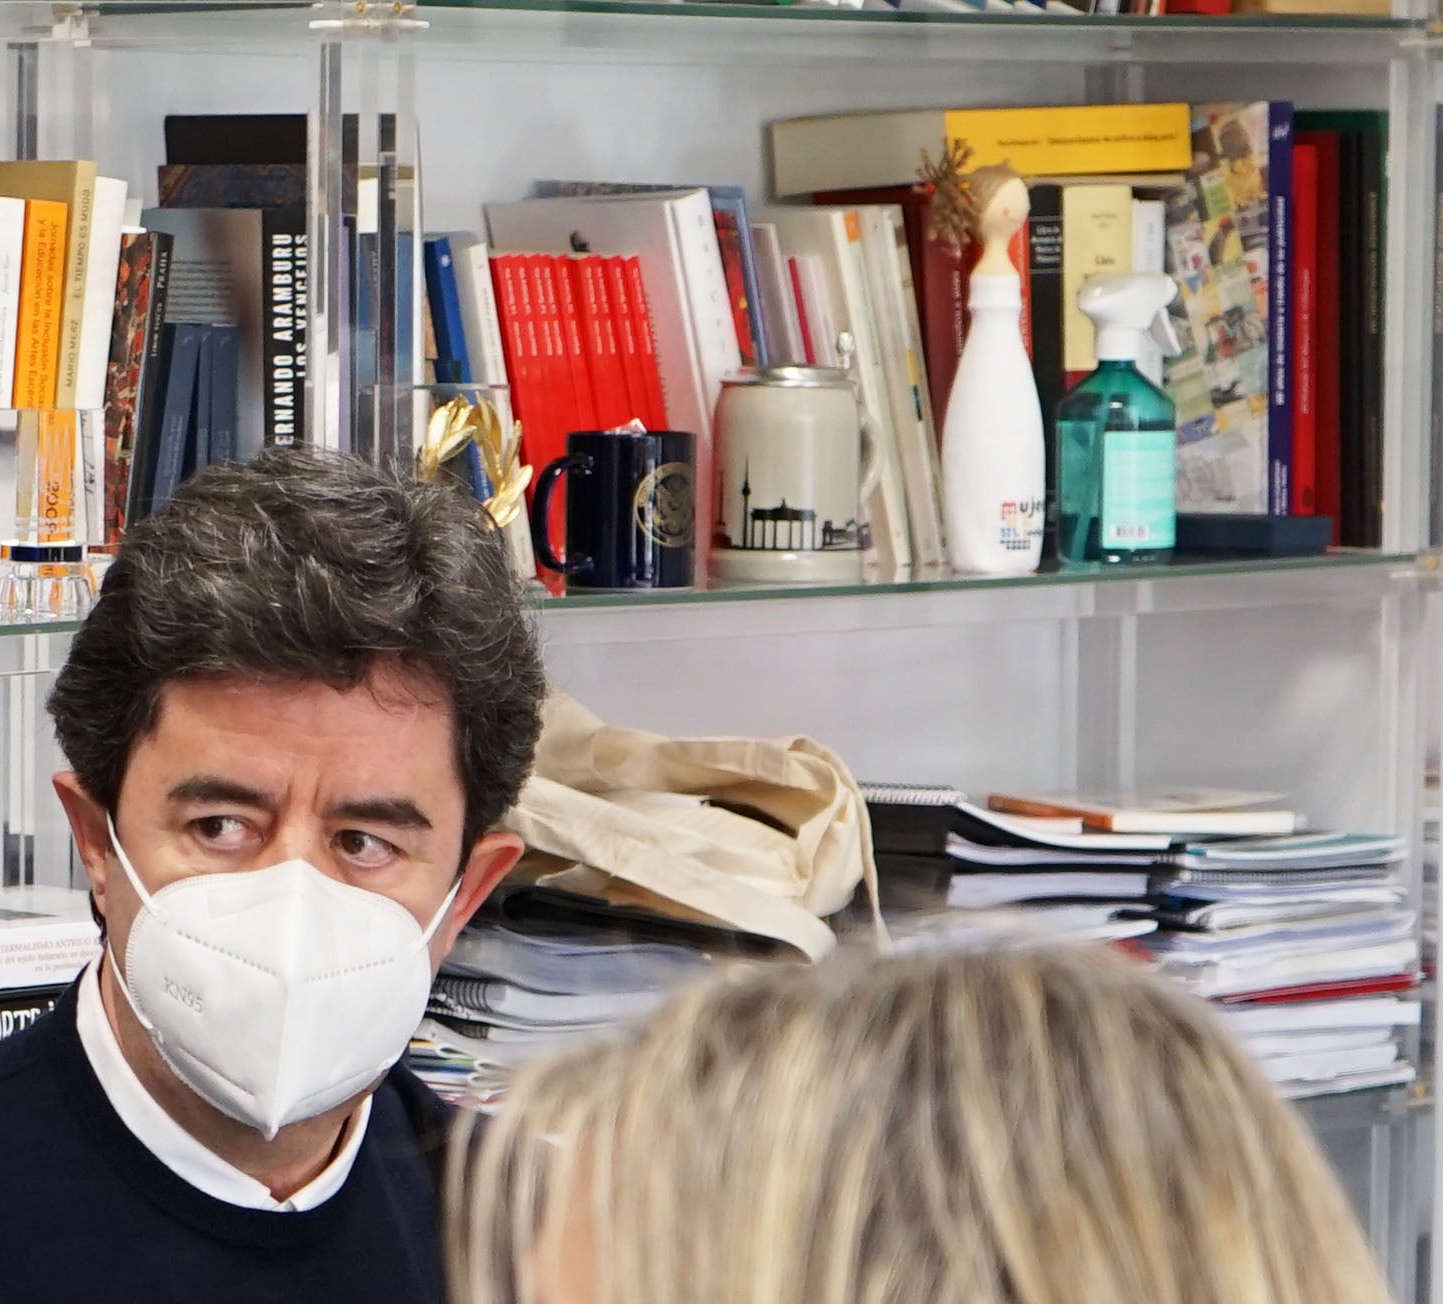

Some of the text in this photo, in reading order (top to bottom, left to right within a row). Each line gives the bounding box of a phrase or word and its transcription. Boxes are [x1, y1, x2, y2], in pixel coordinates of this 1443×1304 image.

[65, 189, 91, 388] MARIO MERZ EL TIEMPO ES MUDO
[272, 233, 294, 447] ERNANDO ARAMBURU
[0, 937, 91, 954] TERMALISMO ANTIGUO
